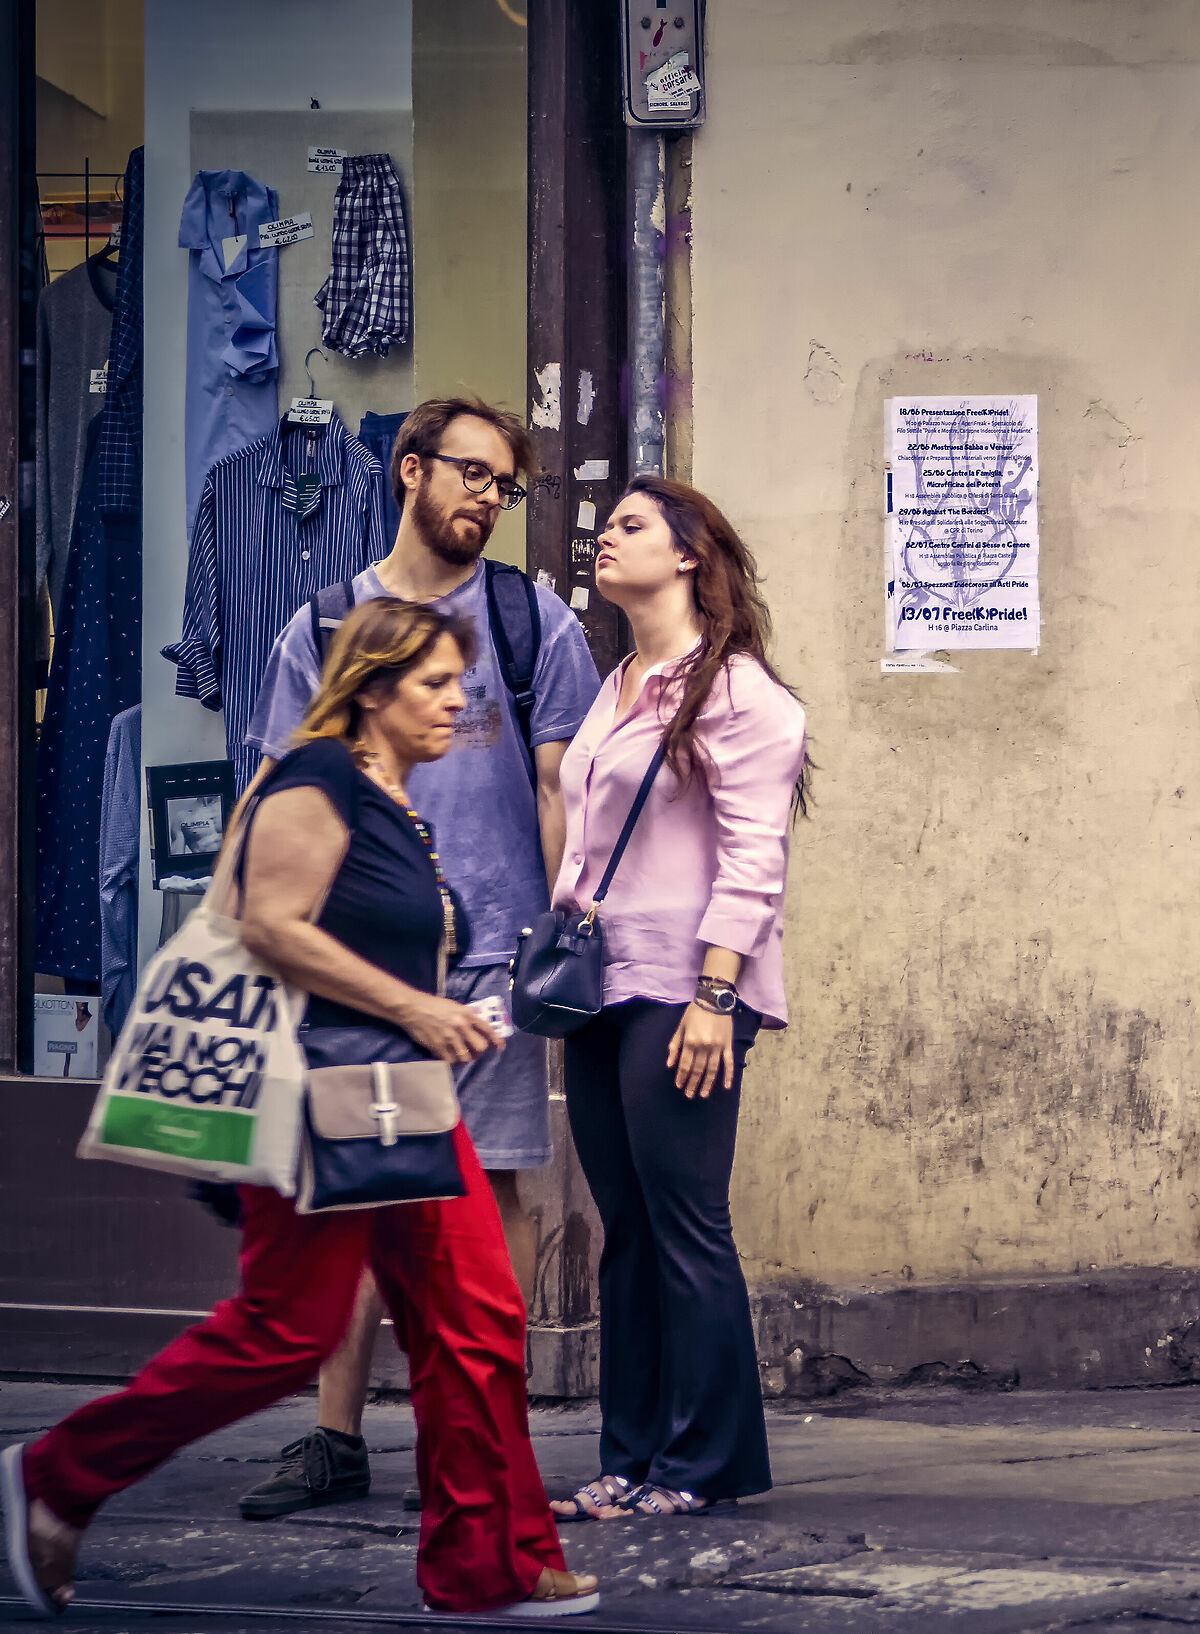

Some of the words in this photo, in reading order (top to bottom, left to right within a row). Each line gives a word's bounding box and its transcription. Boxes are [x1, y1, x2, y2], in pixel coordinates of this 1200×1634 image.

[268, 218, 294, 230] OLIMPIA
[900, 408, 920, 416] 18/06
[902, 607, 940, 620] 13/07
[943, 607, 1028, 620] Free(K)Pride!
